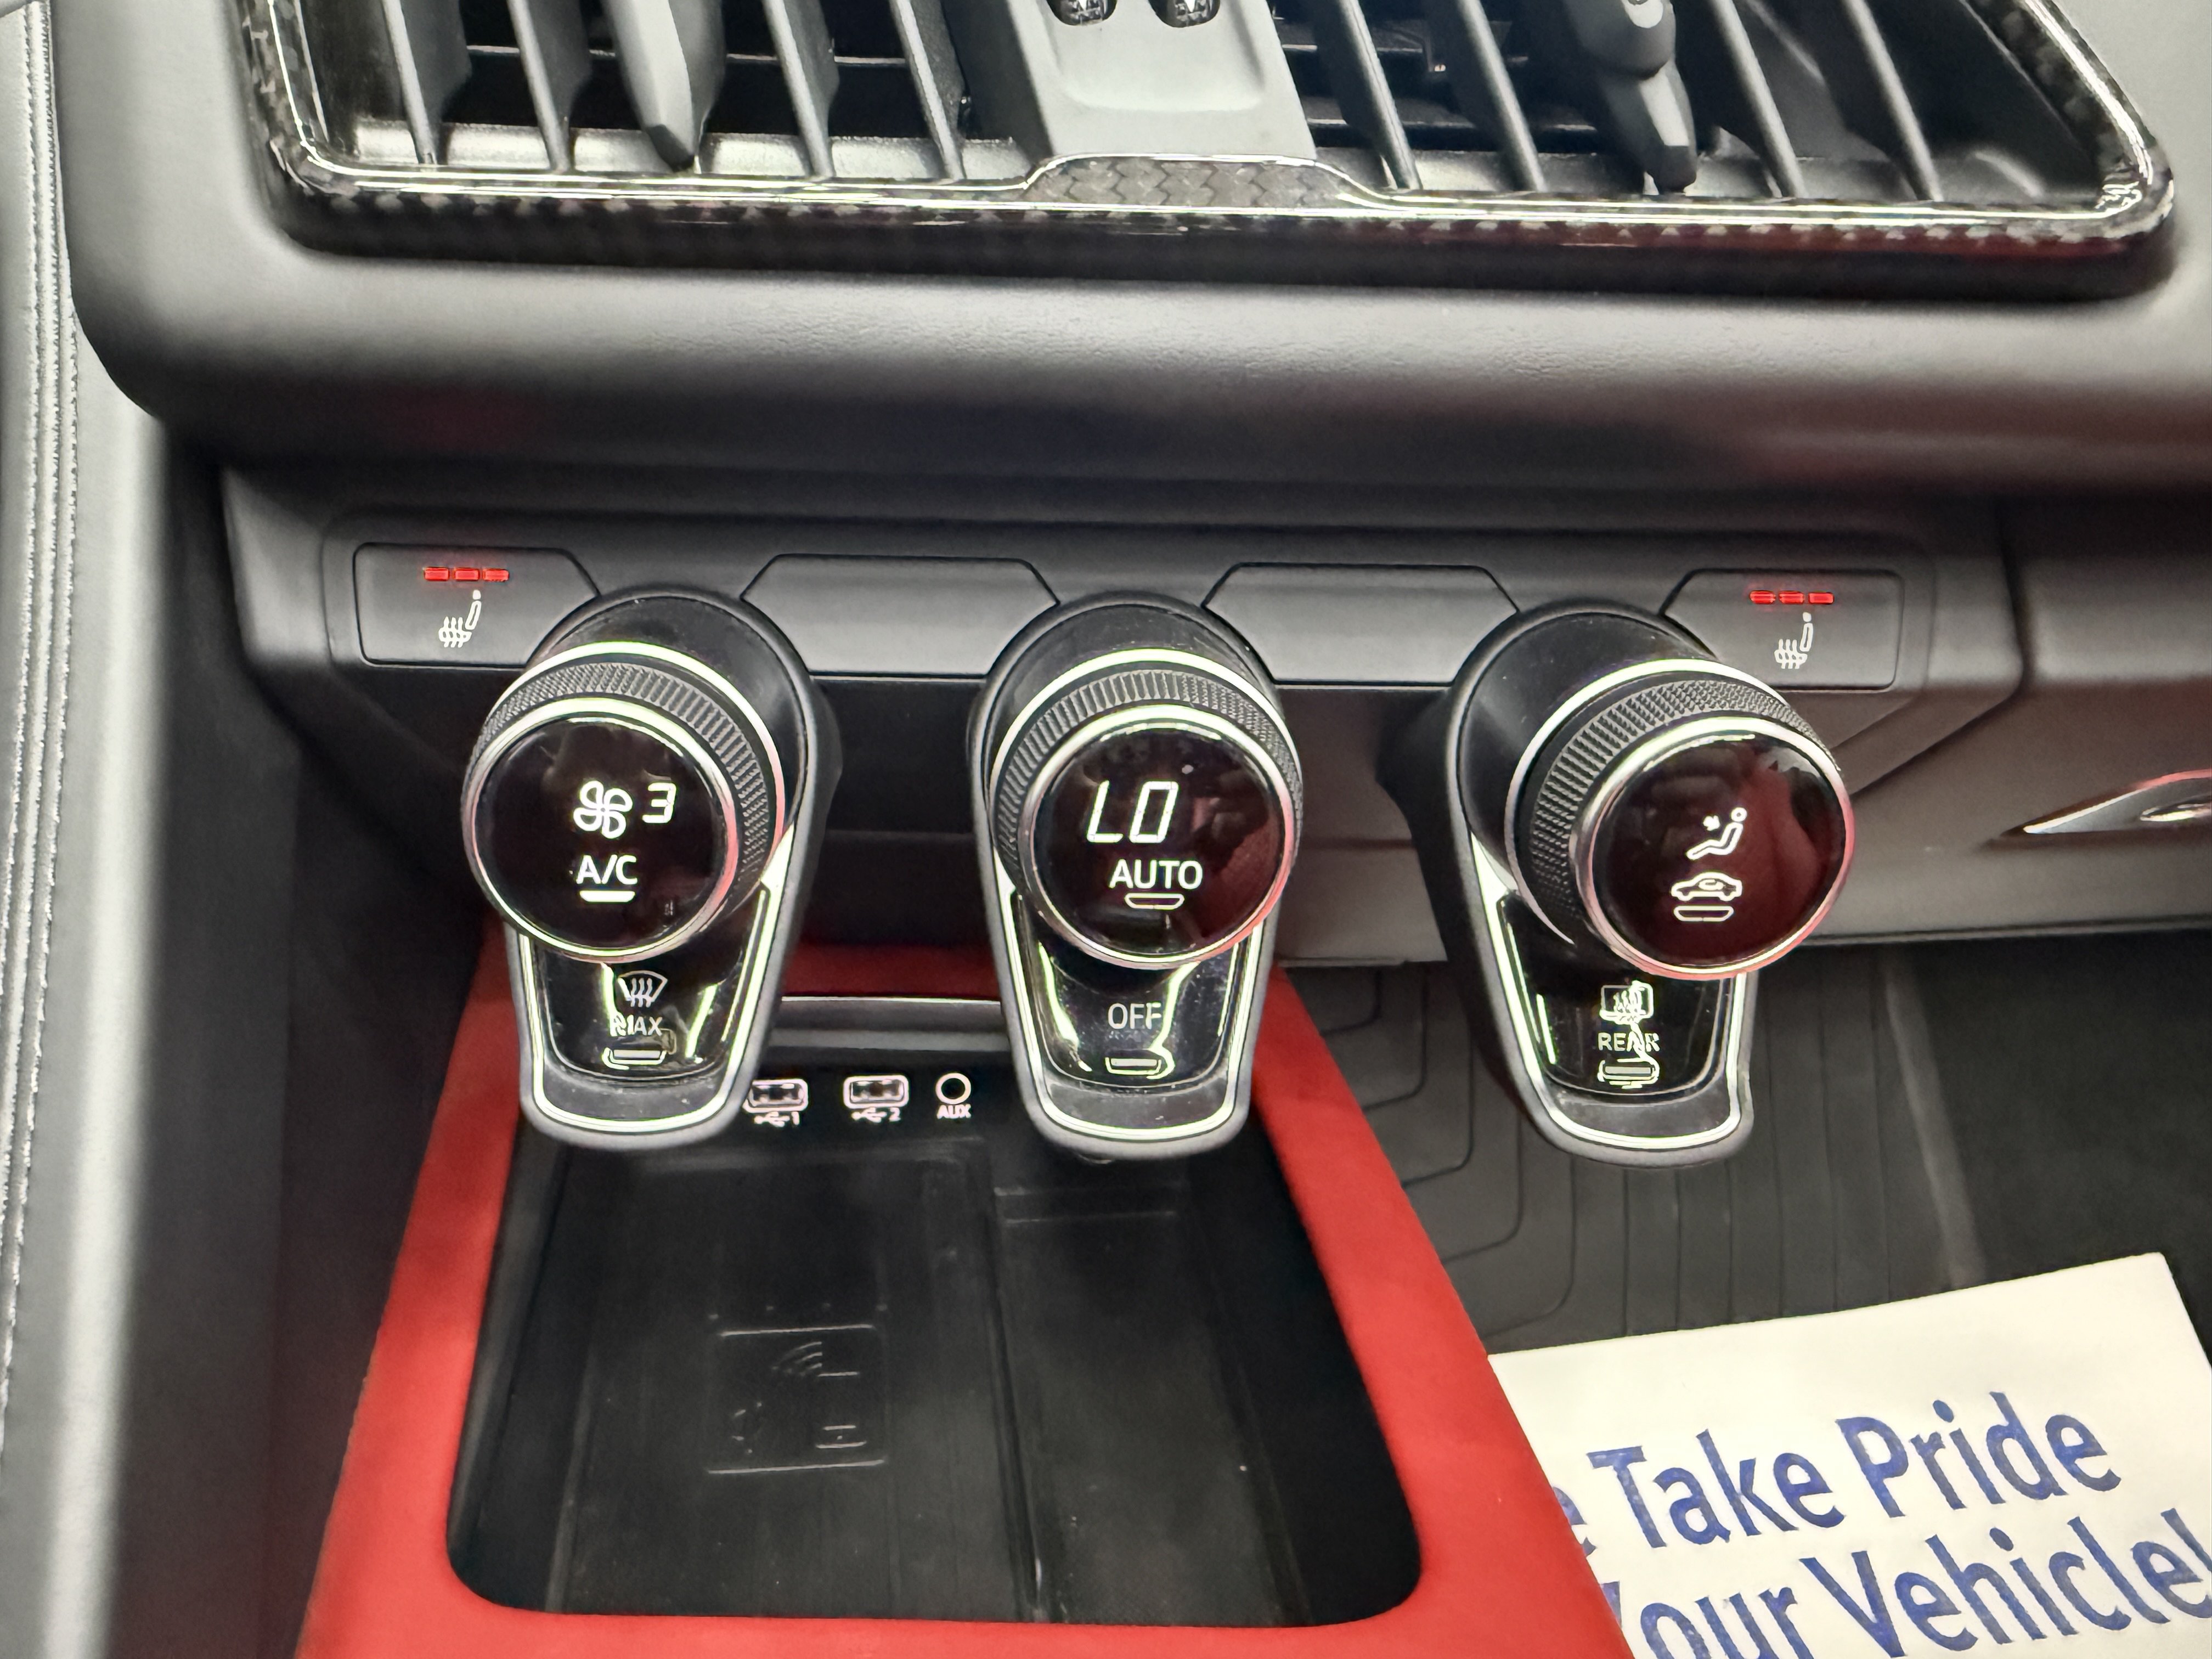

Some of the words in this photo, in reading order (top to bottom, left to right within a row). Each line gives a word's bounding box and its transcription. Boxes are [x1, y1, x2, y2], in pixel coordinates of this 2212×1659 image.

[642, 782, 676, 823] 3
[1086, 780, 1179, 844] LO
[575, 854, 638, 885] A/C
[1109, 859, 1203, 890] AUTO
[610, 1014, 663, 1036] MAX
[1108, 1002, 1162, 1030] OFF
[1598, 1031, 1660, 1052] REAR
[936, 1103, 972, 1120] AUX
[1587, 1429, 1845, 1548] Take
[1836, 1391, 2121, 1518] Pride
[1599, 1581, 1814, 1659] our
